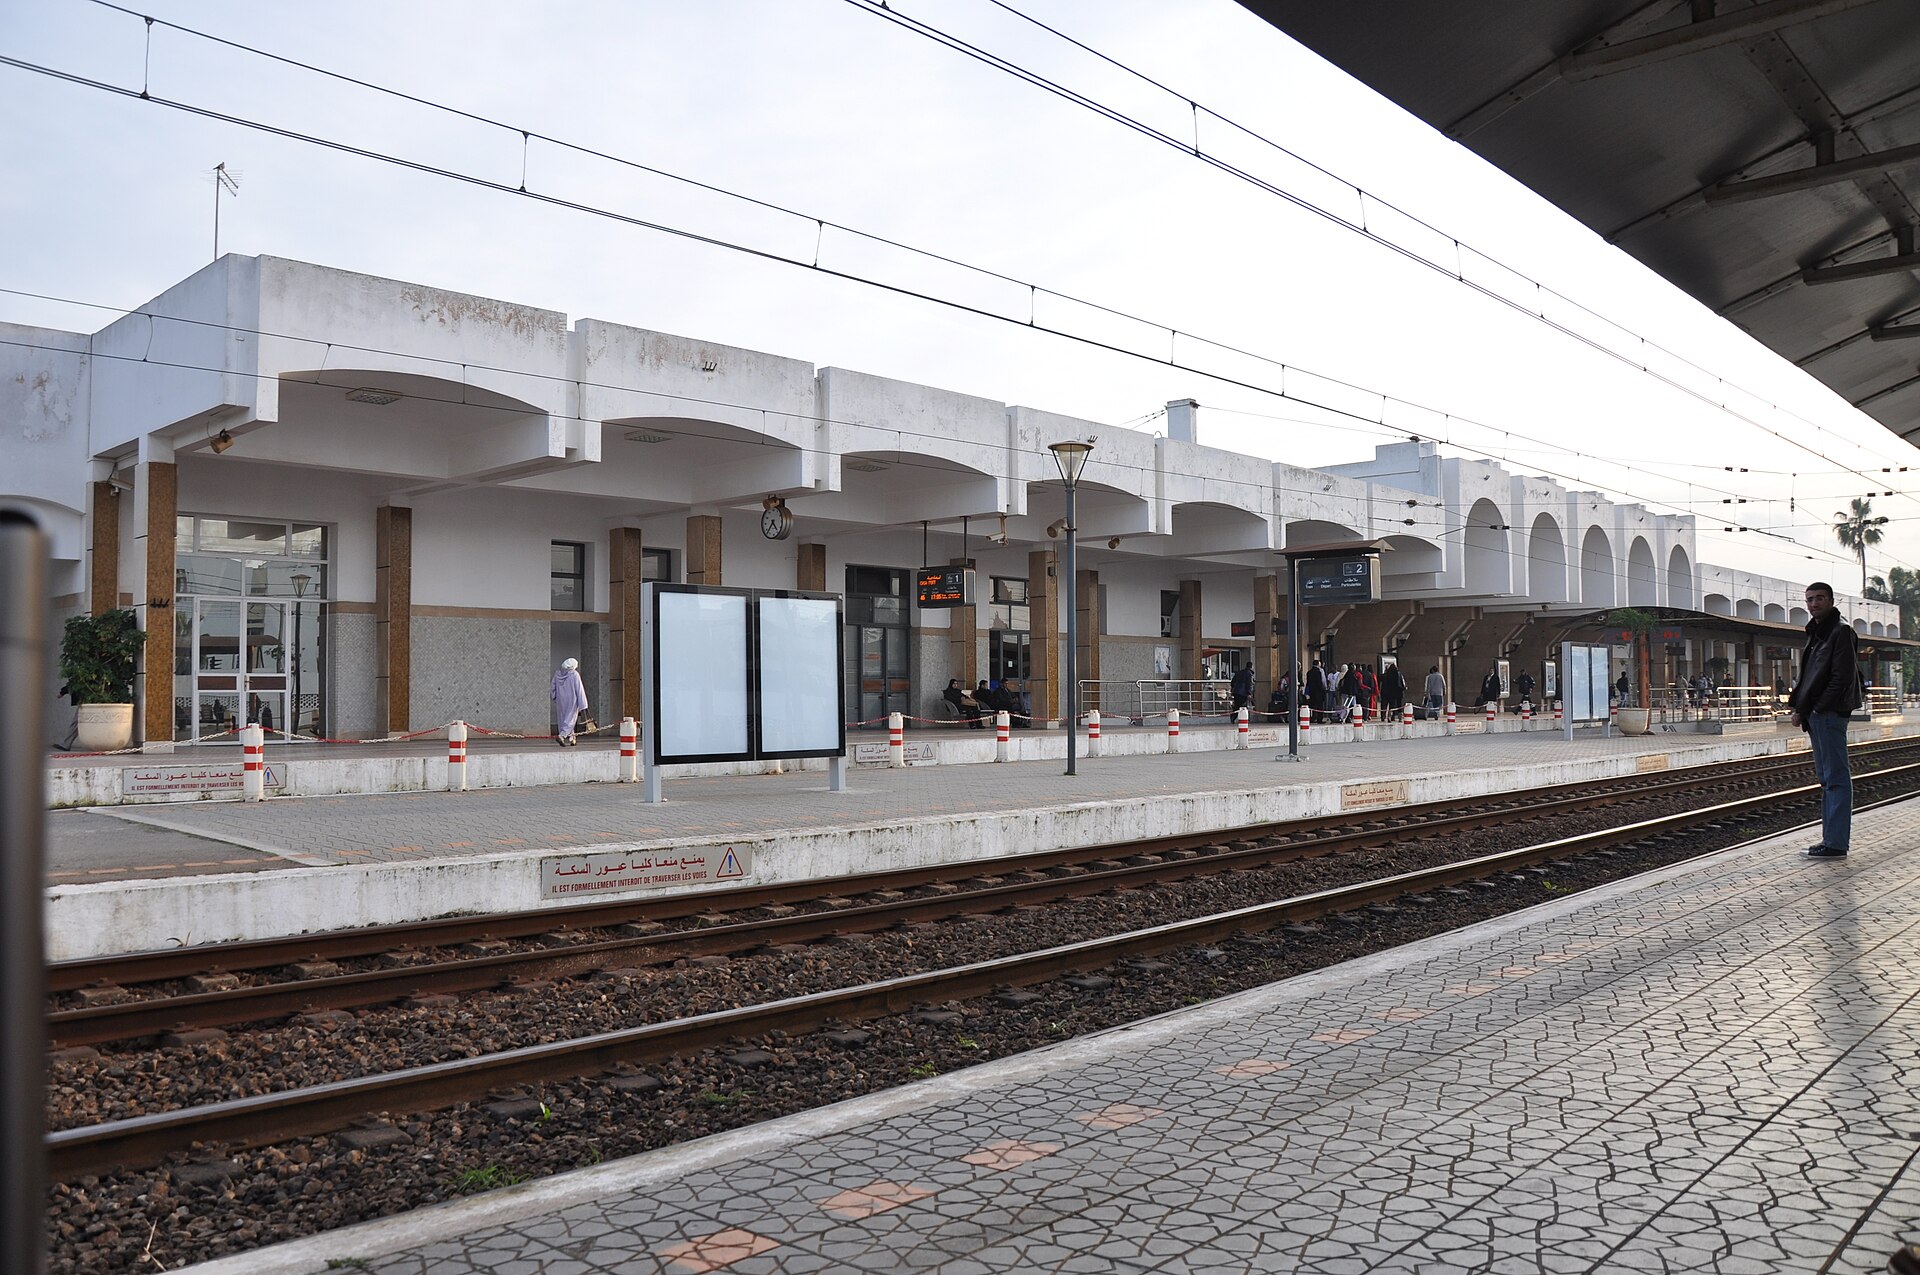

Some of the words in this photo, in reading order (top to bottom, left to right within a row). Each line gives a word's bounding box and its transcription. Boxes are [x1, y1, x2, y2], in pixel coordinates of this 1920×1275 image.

[1356, 564, 1363, 573] 2
[631, 858, 652, 872] كليا
[655, 856, 678, 867] منعا
[680, 854, 705, 870] يمنع
[555, 862, 591, 876] السكة
[595, 862, 627, 876] عبور
[552, 885, 558, 893] IL
[559, 884, 570, 892] EST
[571, 880, 617, 892] FORMELLEMENT
[618, 877, 642, 887] INTERDIT
[644, 876, 650, 884] DE
[652, 873, 681, 883] TRAVERSER
[682, 872, 692, 880] LES
[693, 871, 707, 880] VOIES
